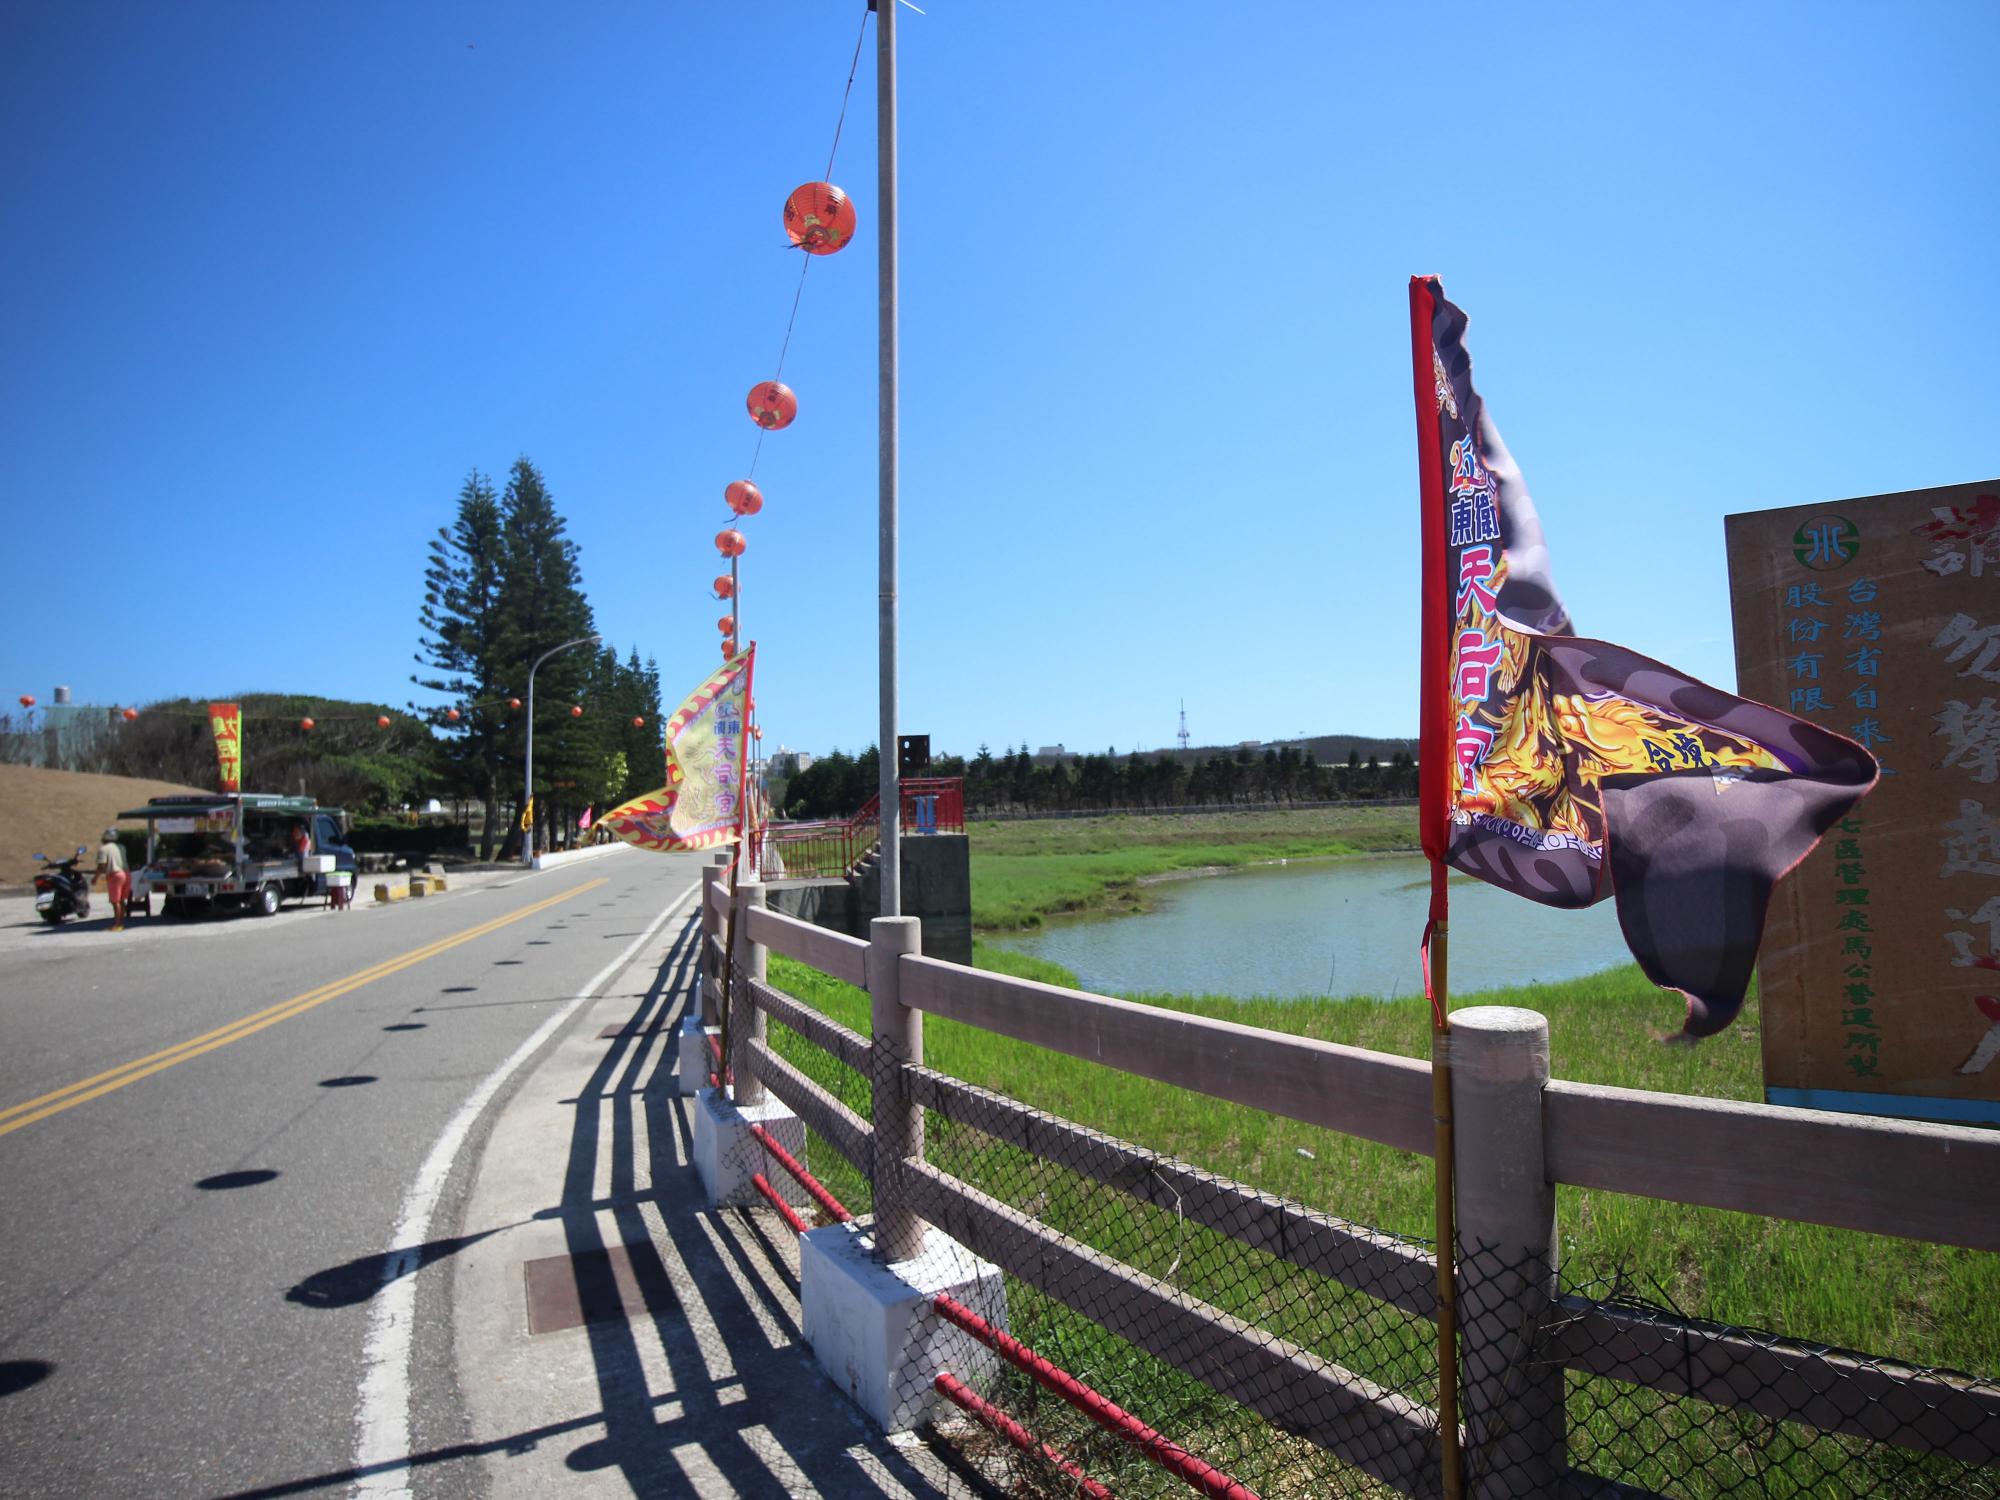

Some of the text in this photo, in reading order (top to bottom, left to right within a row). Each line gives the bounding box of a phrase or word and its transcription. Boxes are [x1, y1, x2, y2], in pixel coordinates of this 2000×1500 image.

[1453, 545, 1505, 795] 天后宮
[1783, 581, 1836, 713] 股份有限
